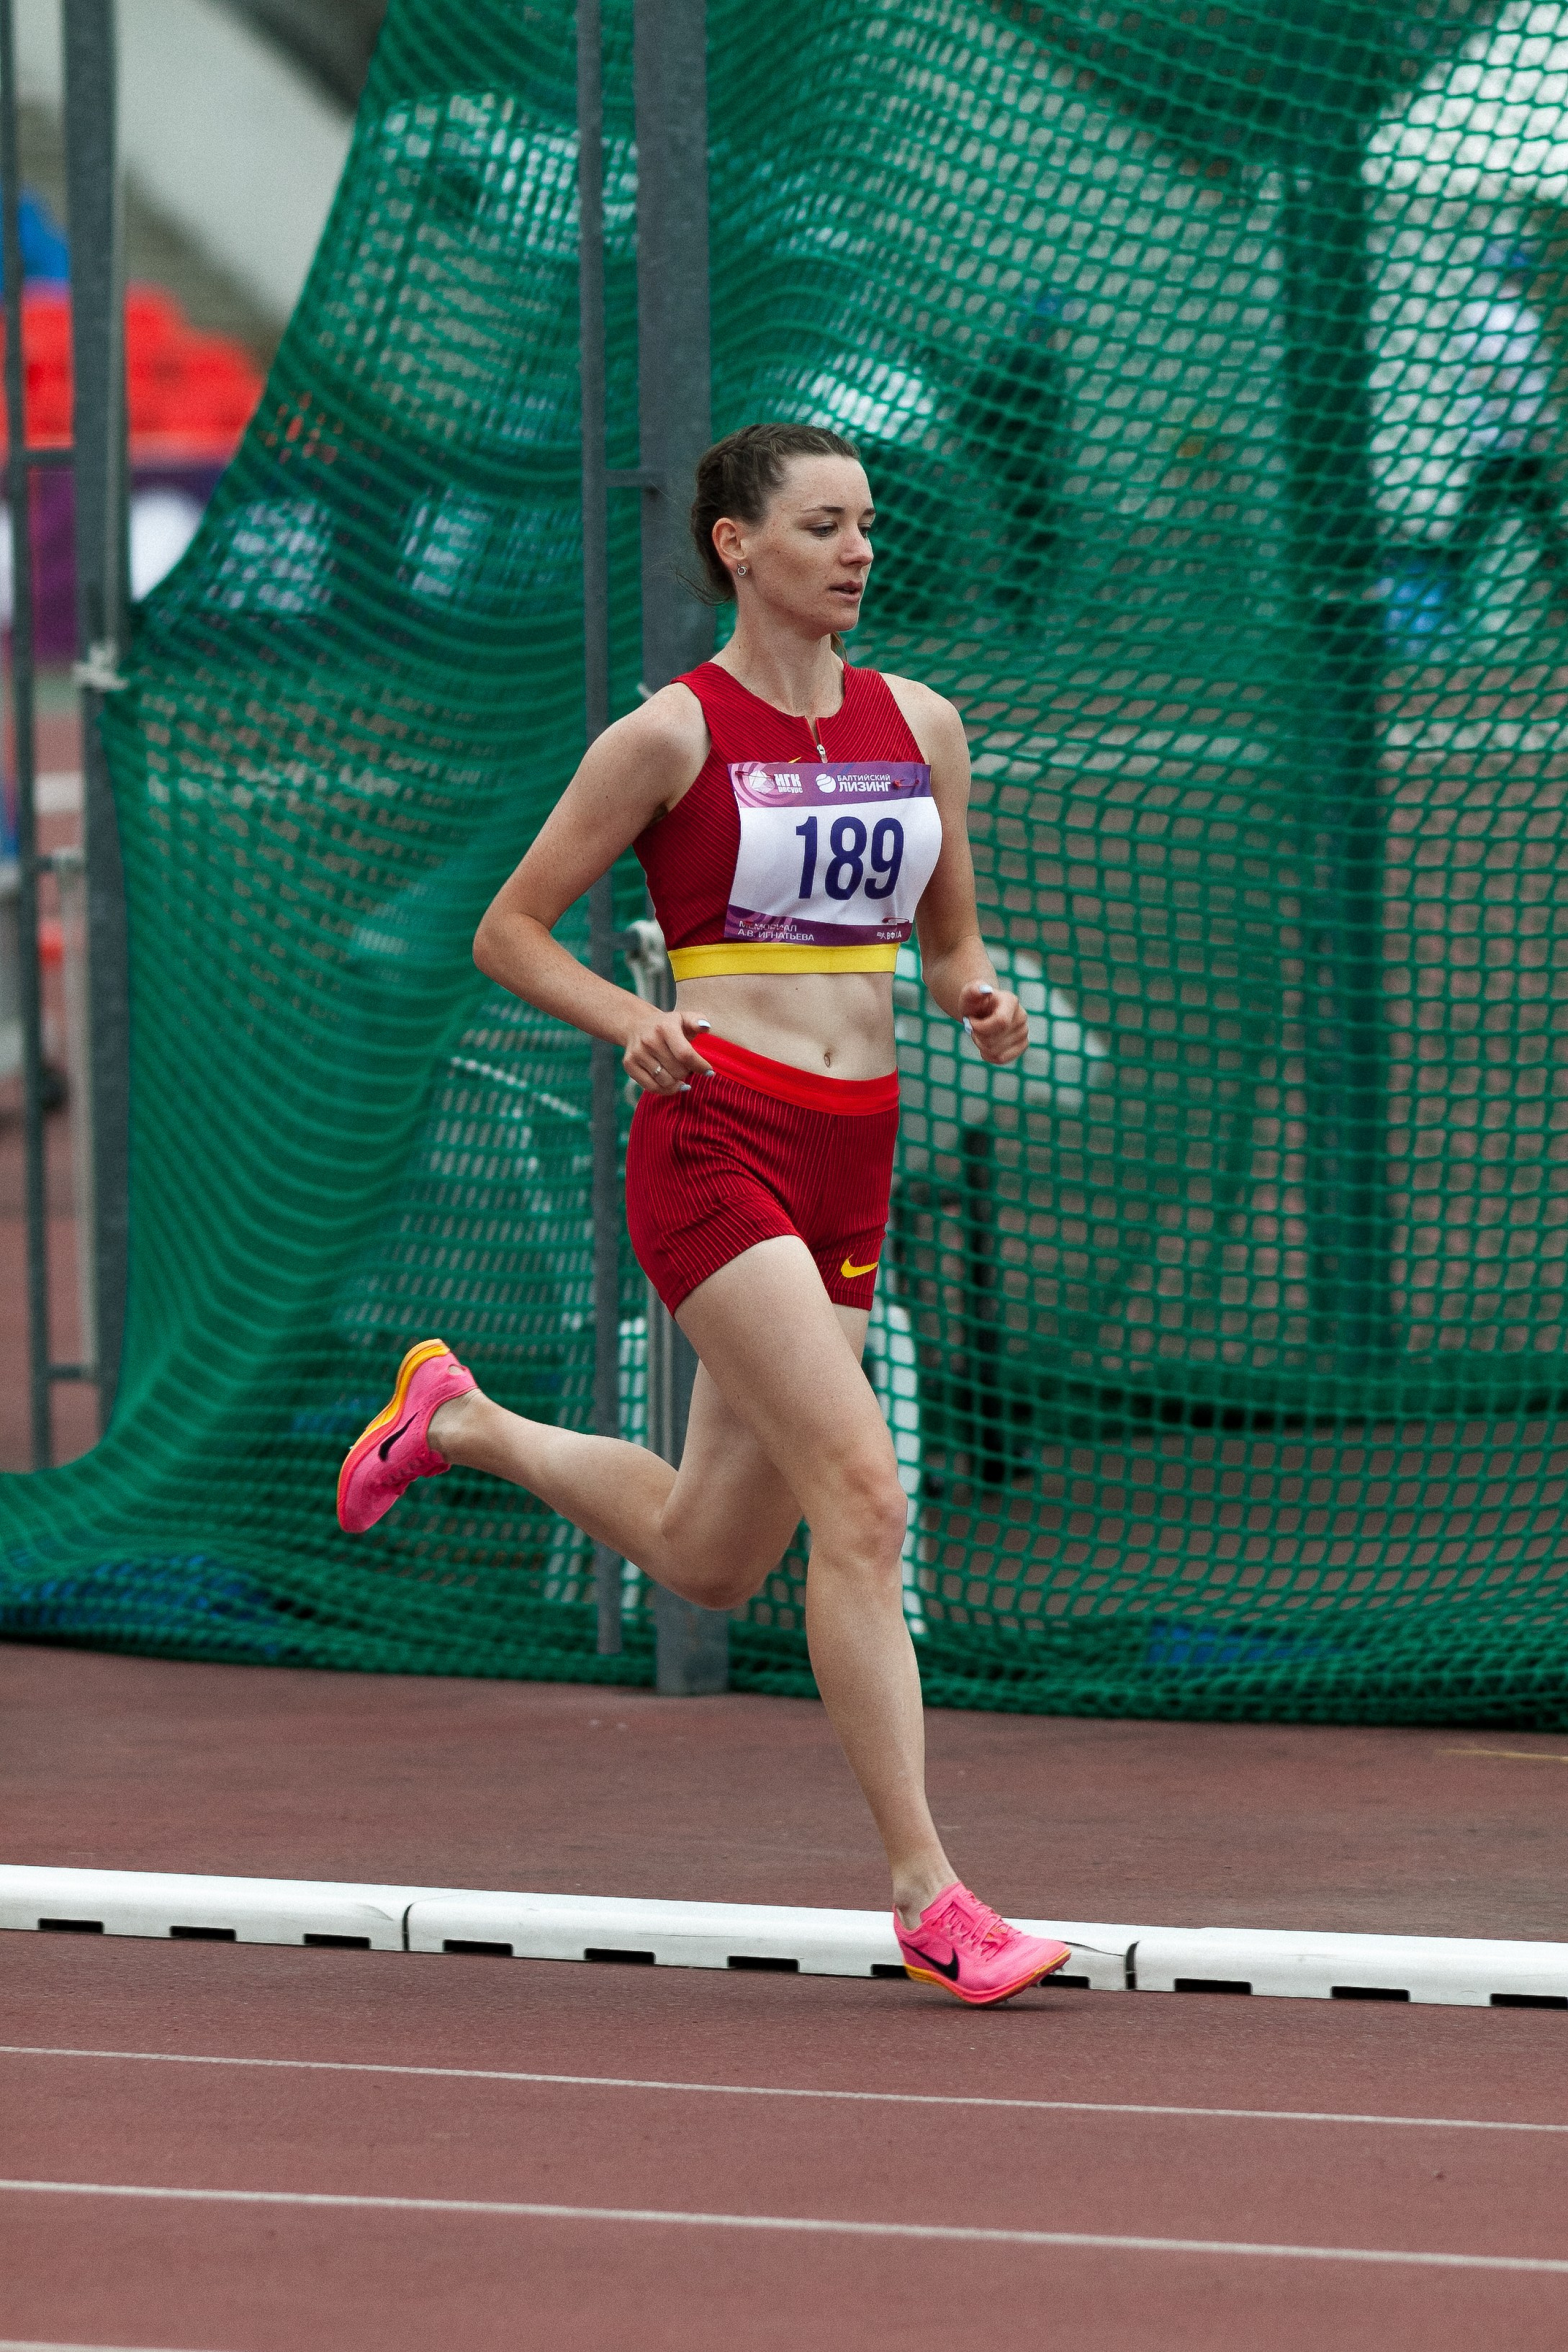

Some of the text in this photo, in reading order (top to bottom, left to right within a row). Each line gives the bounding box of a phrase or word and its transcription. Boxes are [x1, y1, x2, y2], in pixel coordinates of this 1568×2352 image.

[837, 773, 891, 782] БАЛТИЙСКИЙ
[839, 781, 891, 793] ЛИЗИНГ
[796, 815, 904, 901] 189
[737, 929, 815, 942] А.В. ИГНАТЬЕВА
